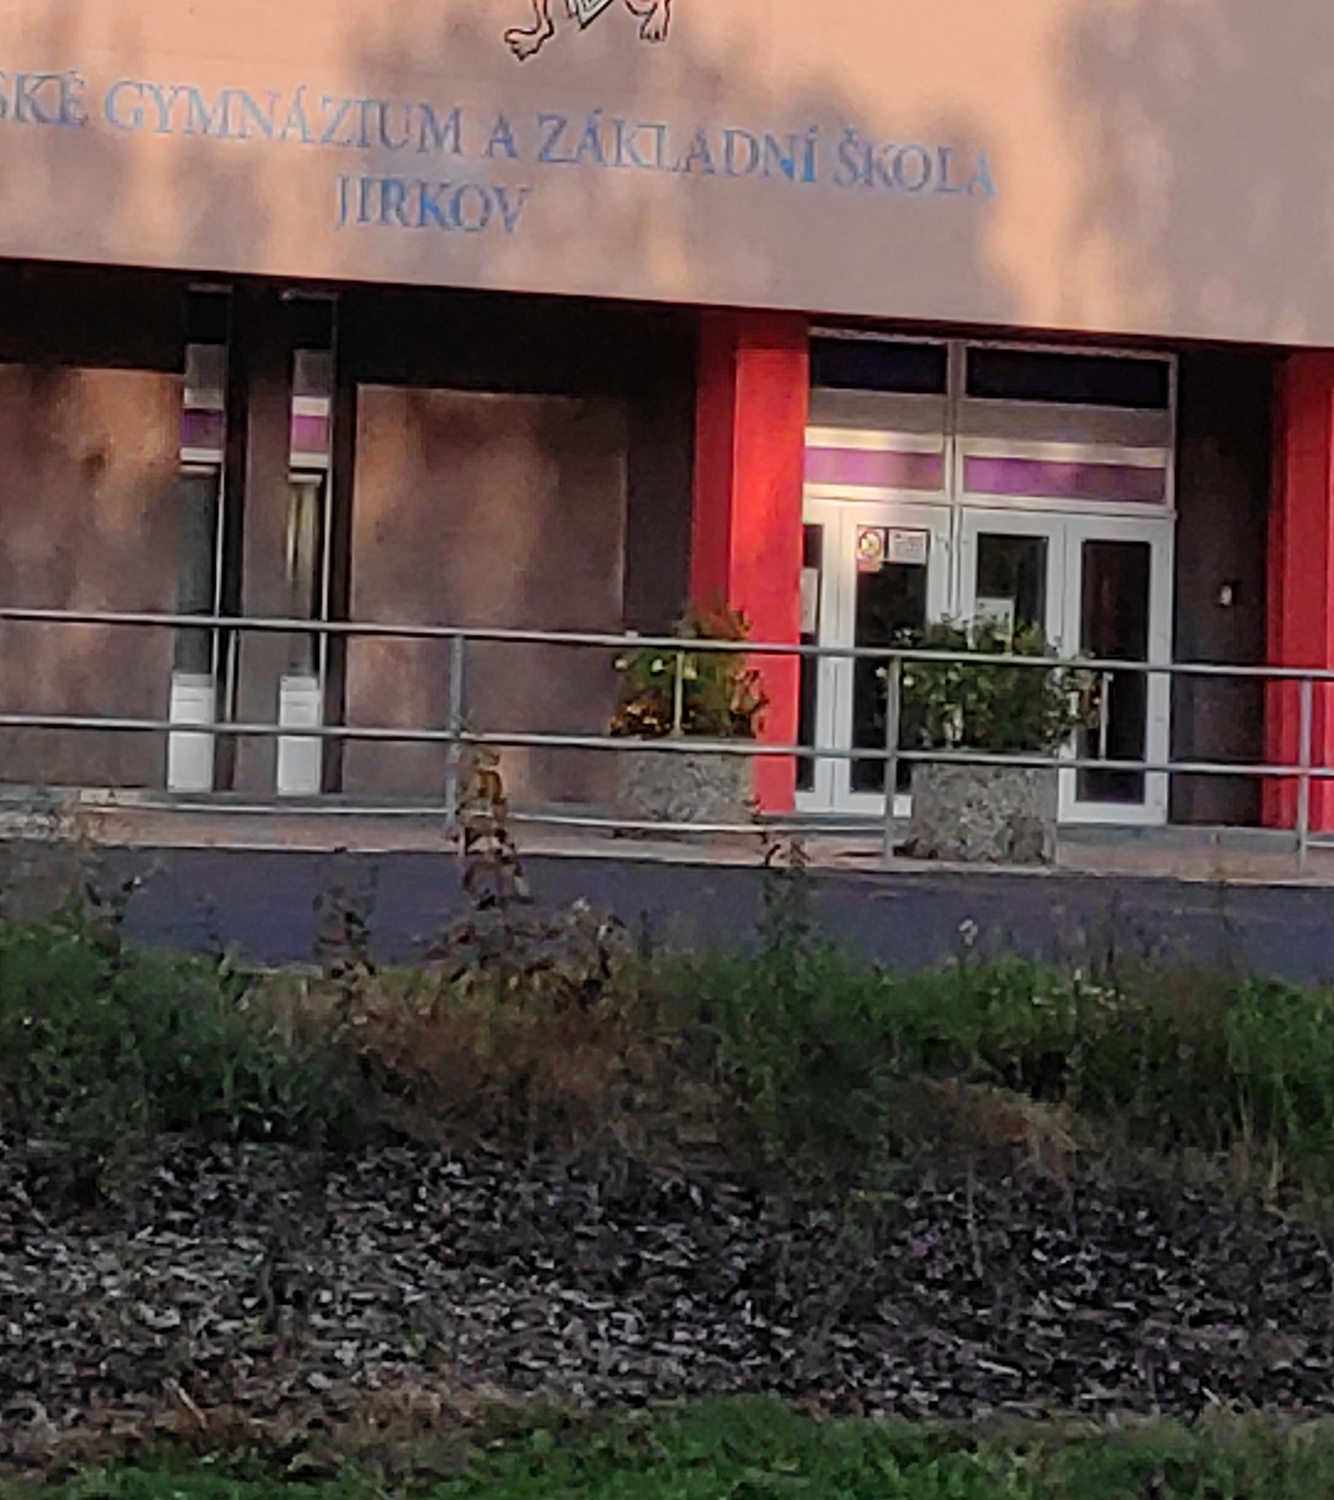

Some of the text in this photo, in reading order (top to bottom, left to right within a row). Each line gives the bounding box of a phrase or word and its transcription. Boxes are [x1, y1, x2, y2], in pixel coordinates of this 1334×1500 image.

[105, 79, 462, 154] GYMNÁZIUM
[484, 112, 518, 158] A
[537, 108, 817, 184] ZÁKLADNÍ
[833, 126, 996, 197] ŠKOLA
[336, 175, 530, 235] JIRKOV
